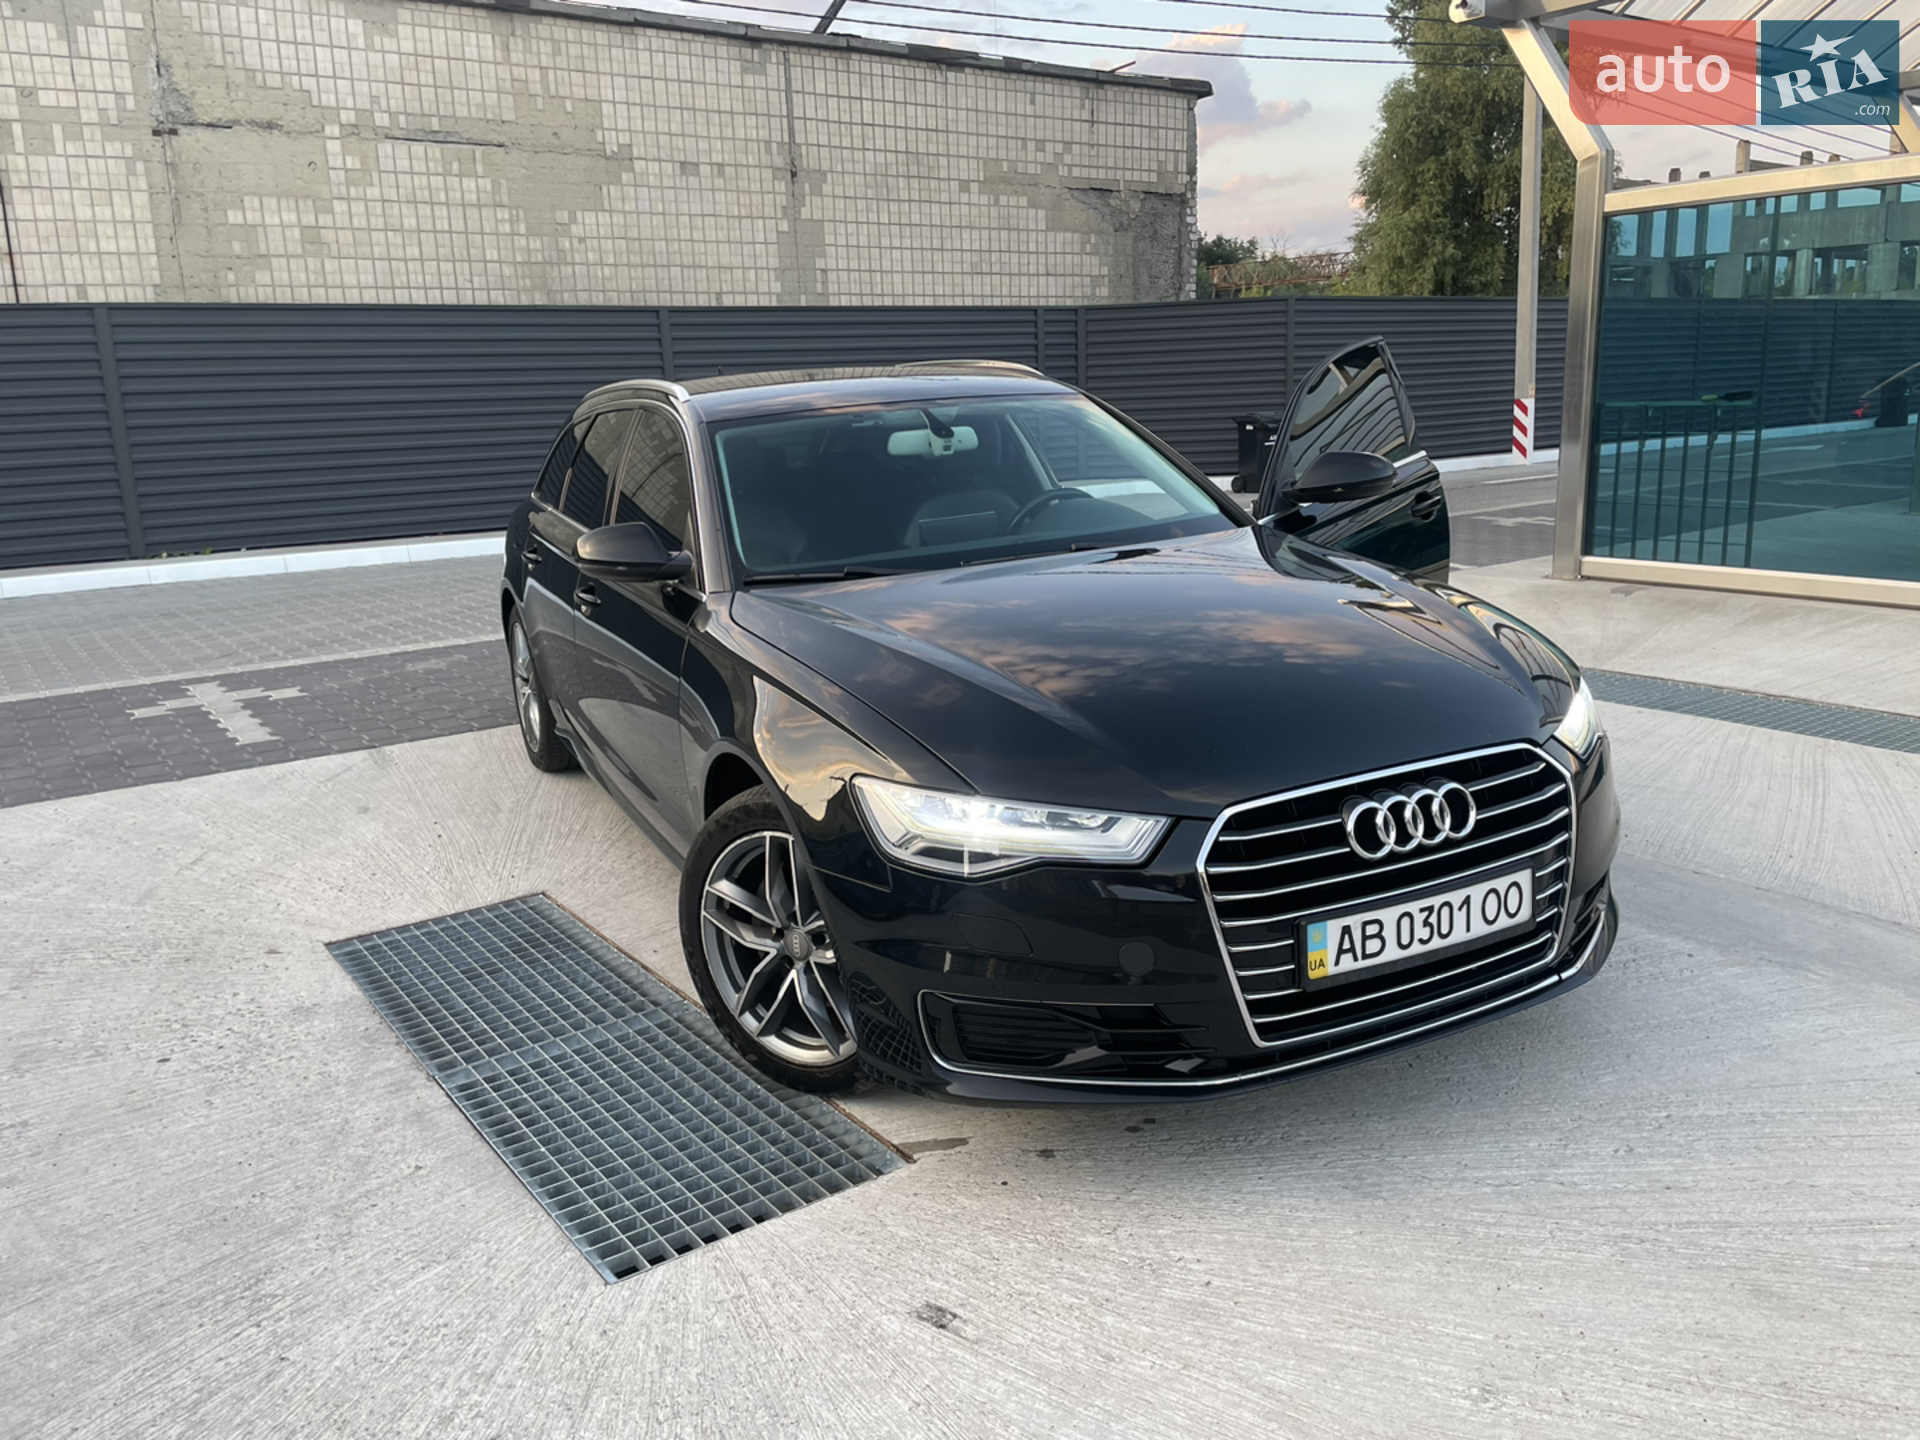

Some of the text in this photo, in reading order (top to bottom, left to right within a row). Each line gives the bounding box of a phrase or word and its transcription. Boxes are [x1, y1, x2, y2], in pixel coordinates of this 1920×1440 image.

[1334, 881, 1523, 967] AB 0301 OO
[1309, 957, 1326, 971] UA
